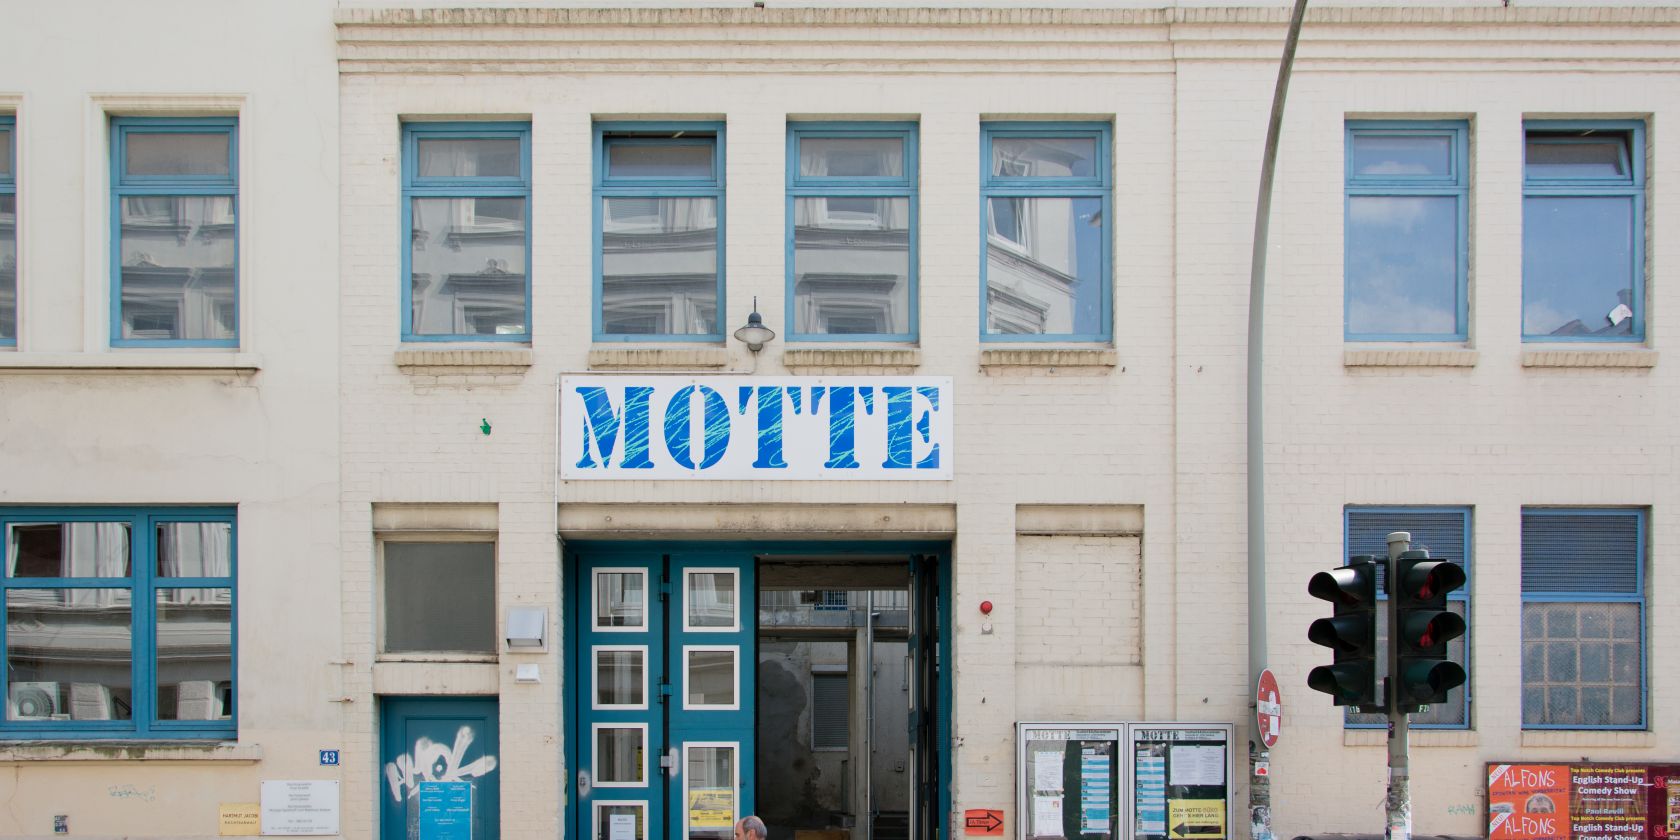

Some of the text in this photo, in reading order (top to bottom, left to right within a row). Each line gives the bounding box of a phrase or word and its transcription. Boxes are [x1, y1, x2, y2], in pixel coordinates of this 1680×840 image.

[575, 384, 940, 470] MOTTE
[1141, 730, 1180, 740] MOTTE
[322, 751, 336, 763] 43
[1504, 769, 1556, 788] ALFONS
[1573, 776, 1644, 785] English Stand-Up
[1578, 787, 1637, 796] Comedy Show
[1505, 816, 1556, 835] ALFONS
[1573, 824, 1644, 833] English Stand-Up
